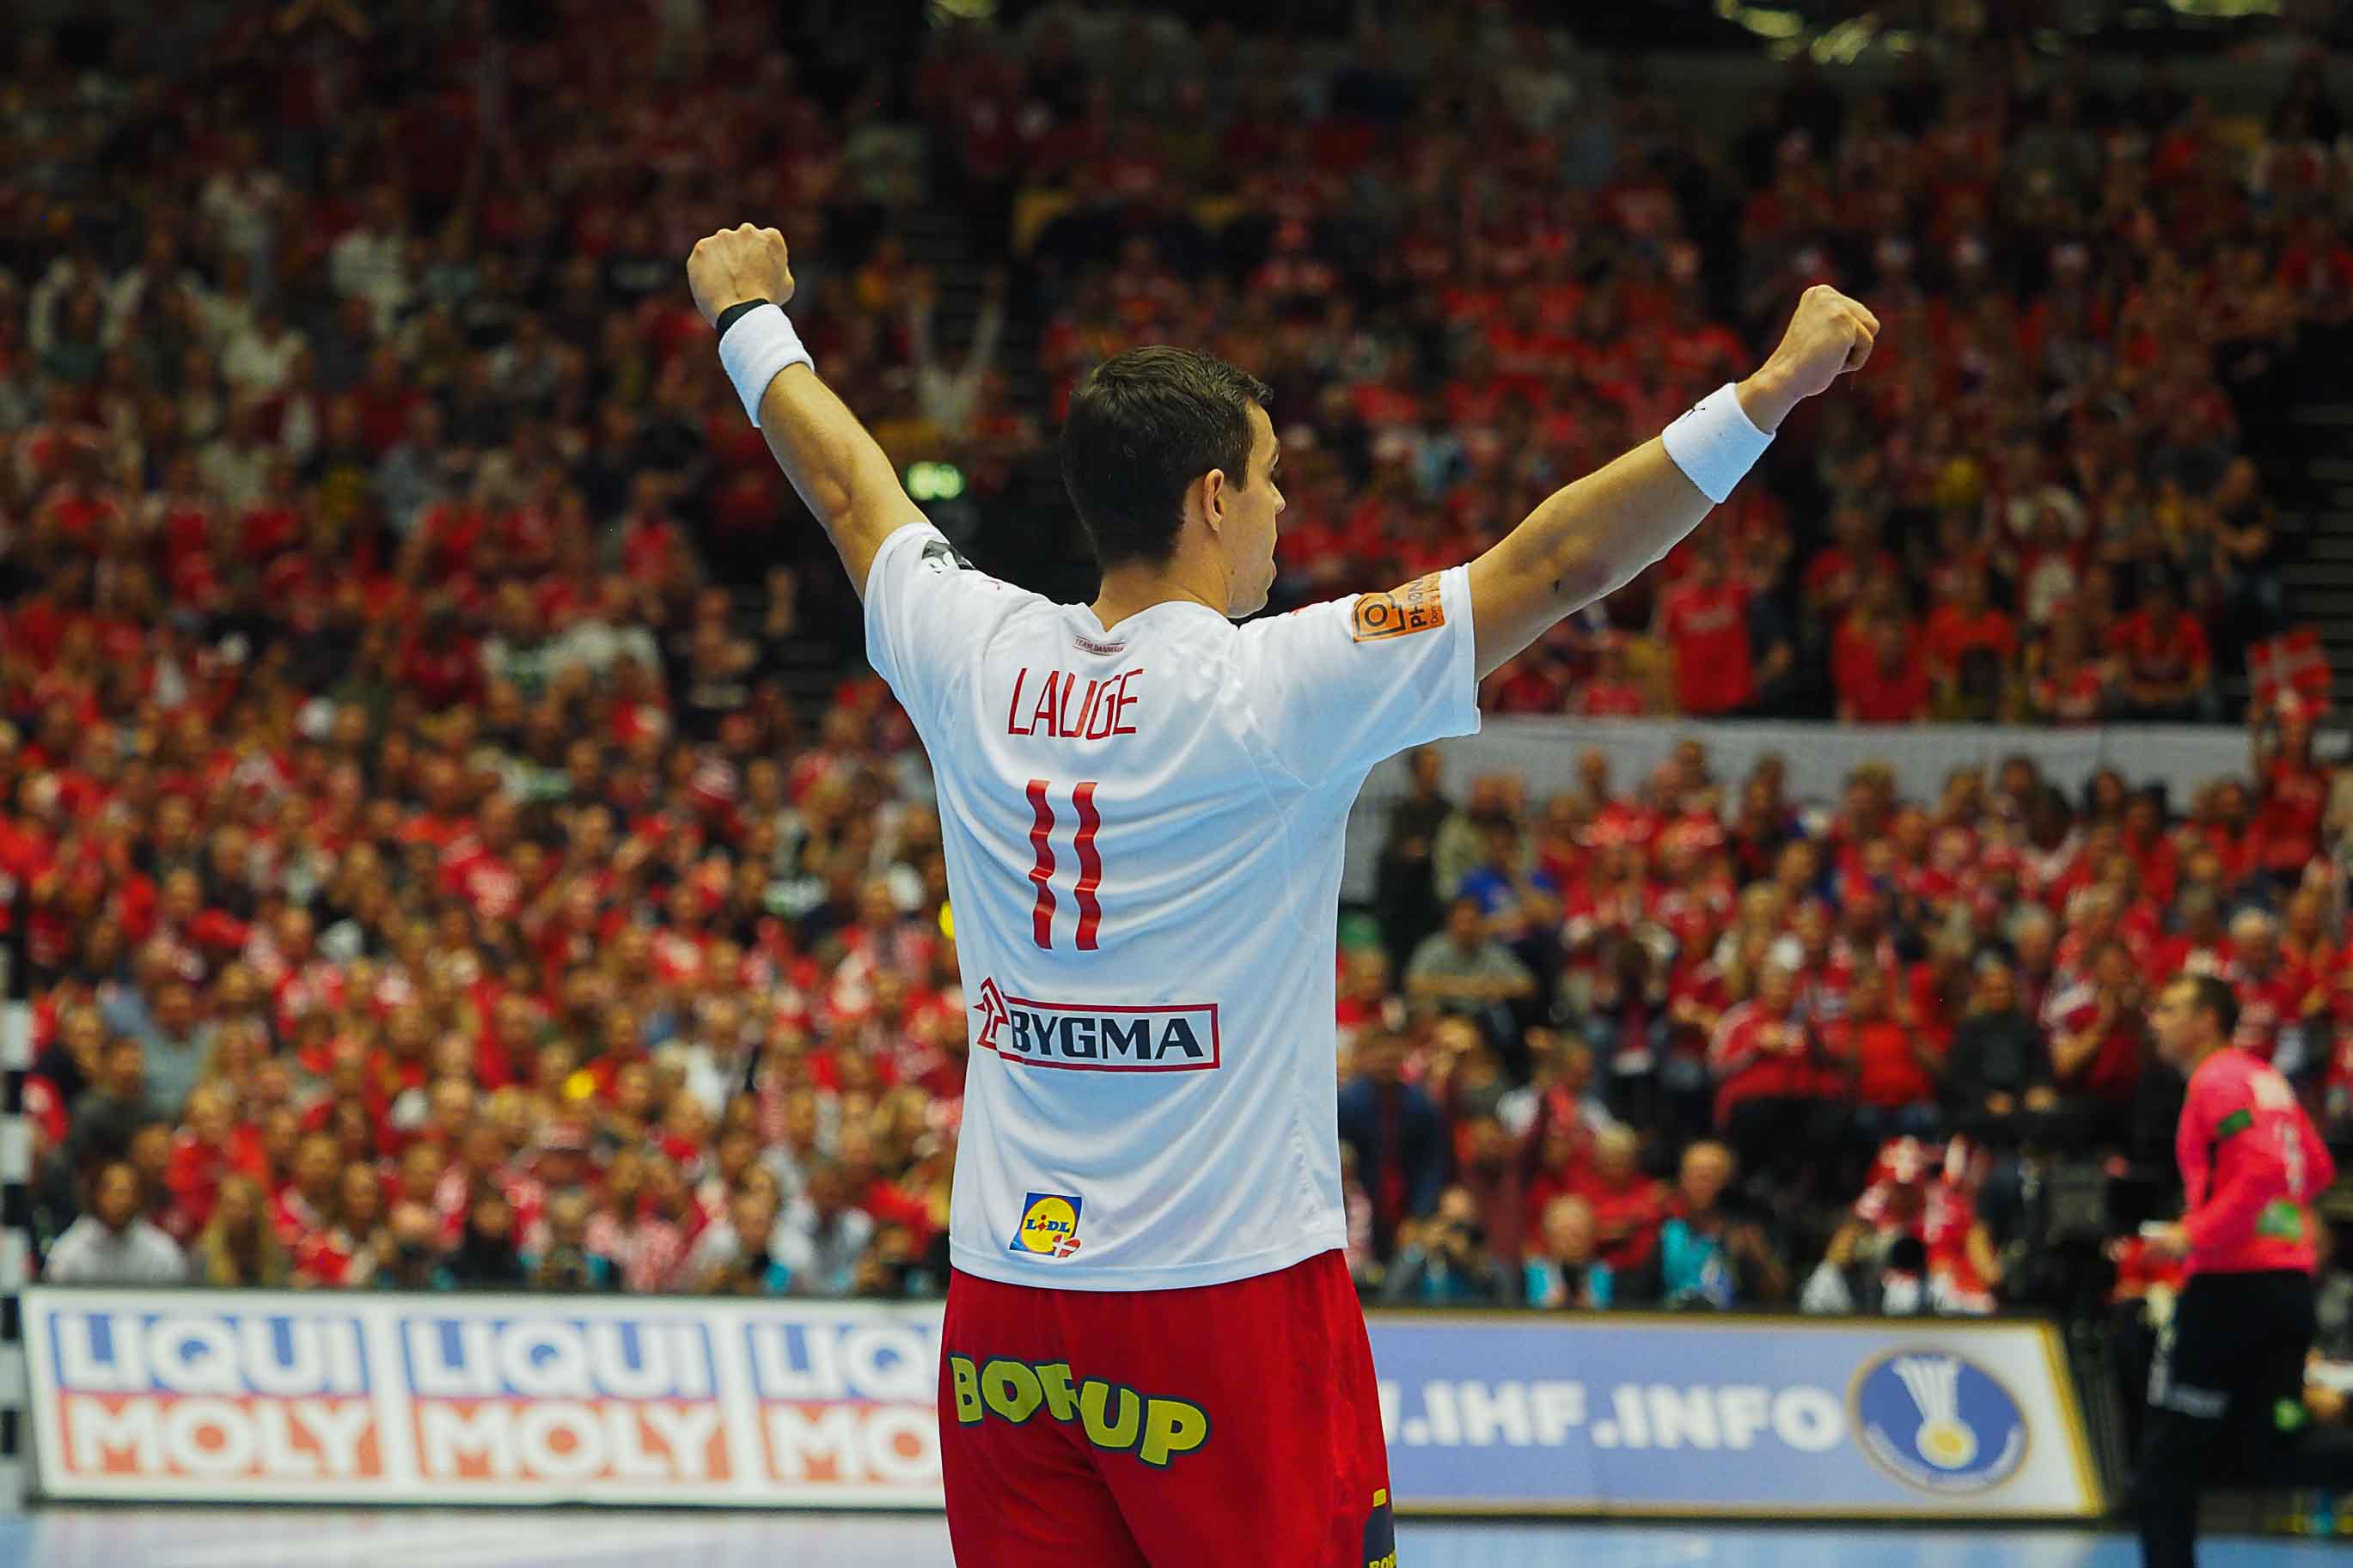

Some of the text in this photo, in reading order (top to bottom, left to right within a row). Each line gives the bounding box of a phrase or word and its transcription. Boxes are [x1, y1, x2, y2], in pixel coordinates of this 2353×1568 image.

[1008, 668, 1145, 740] LAUGE
[1025, 778, 1103, 951] 11
[1010, 1010, 1204, 1060] BYGMA
[57, 1311, 365, 1392] LIQUI
[409, 1316, 712, 1397] LIQUI
[70, 1399, 381, 1478] MOLY
[419, 1402, 733, 1480] MOLY
[1380, 1380, 1848, 1452] .IHF.INFO
